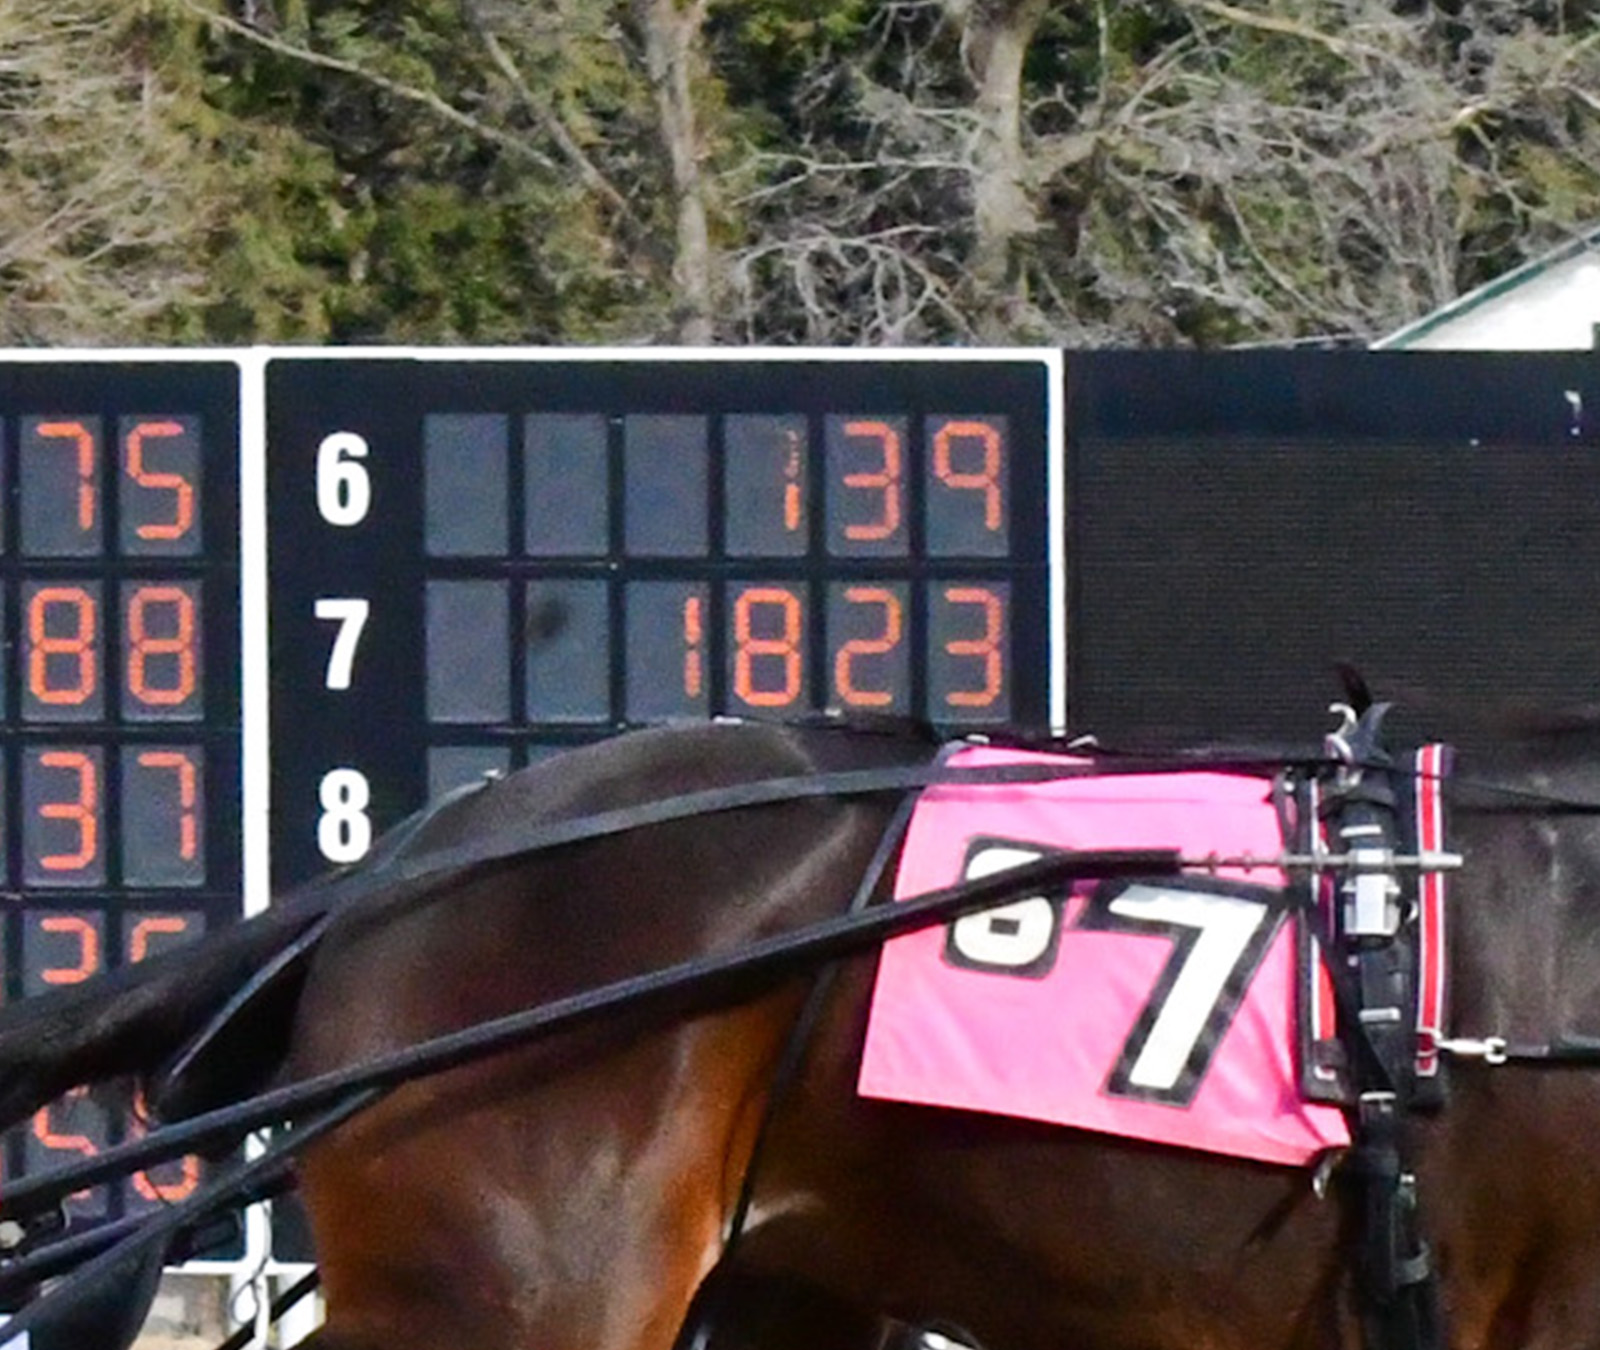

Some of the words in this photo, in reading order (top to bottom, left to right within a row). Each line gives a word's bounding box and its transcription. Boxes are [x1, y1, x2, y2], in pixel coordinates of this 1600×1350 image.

[317, 431, 371, 526] 6
[785, 421, 1001, 540] 139
[29, 587, 195, 705] 88
[314, 599, 369, 690] 7
[685, 588, 1002, 707] 1823
[318, 768, 372, 863] 8
[1102, 880, 1278, 1096] 7
